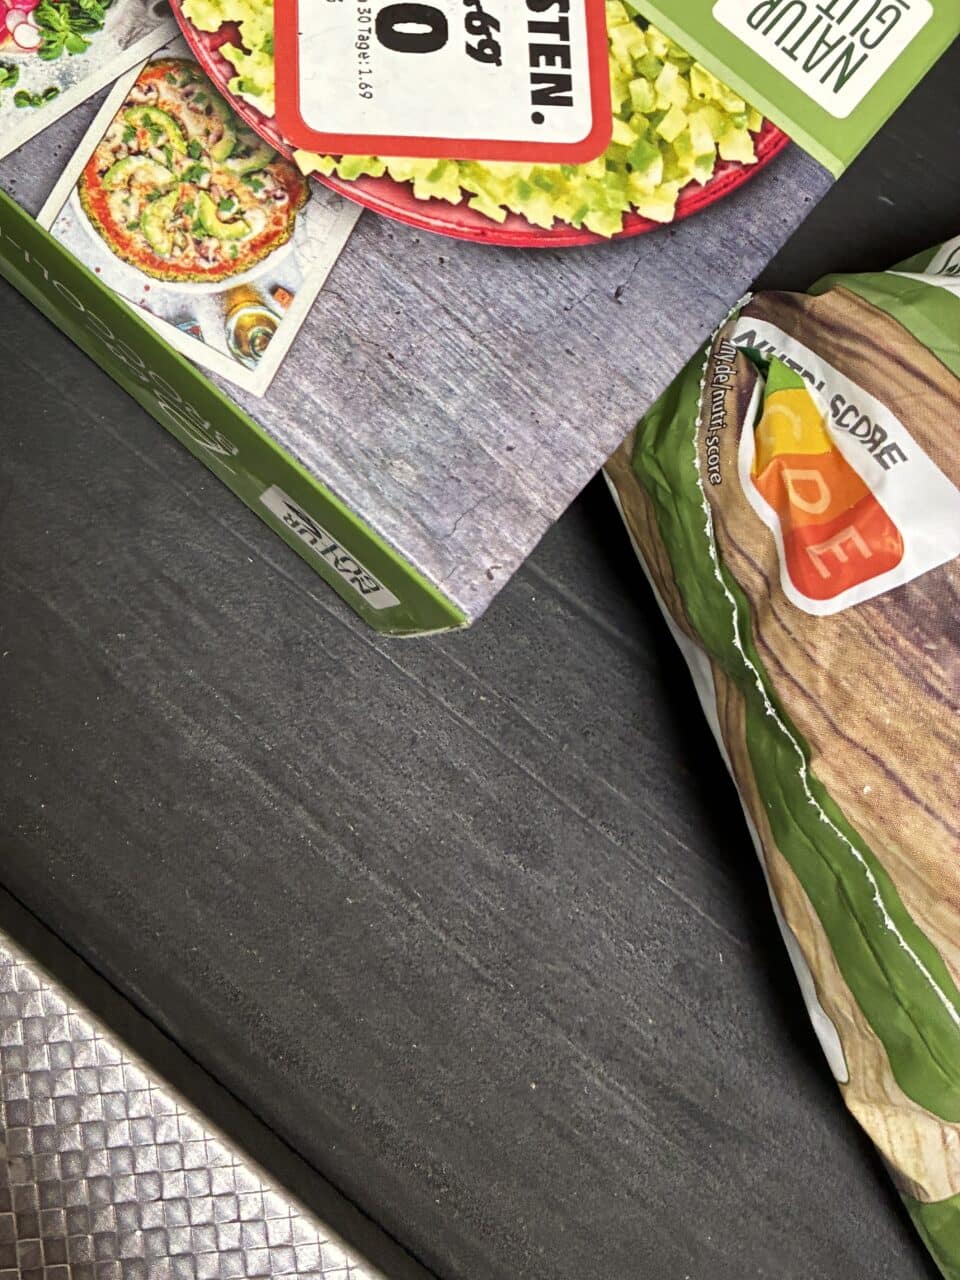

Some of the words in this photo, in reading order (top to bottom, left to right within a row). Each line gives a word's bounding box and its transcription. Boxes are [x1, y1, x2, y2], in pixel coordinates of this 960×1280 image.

[357, 68, 373, 99] 1.69
[782, 469, 832, 515] D
[808, 525, 873, 579] E
